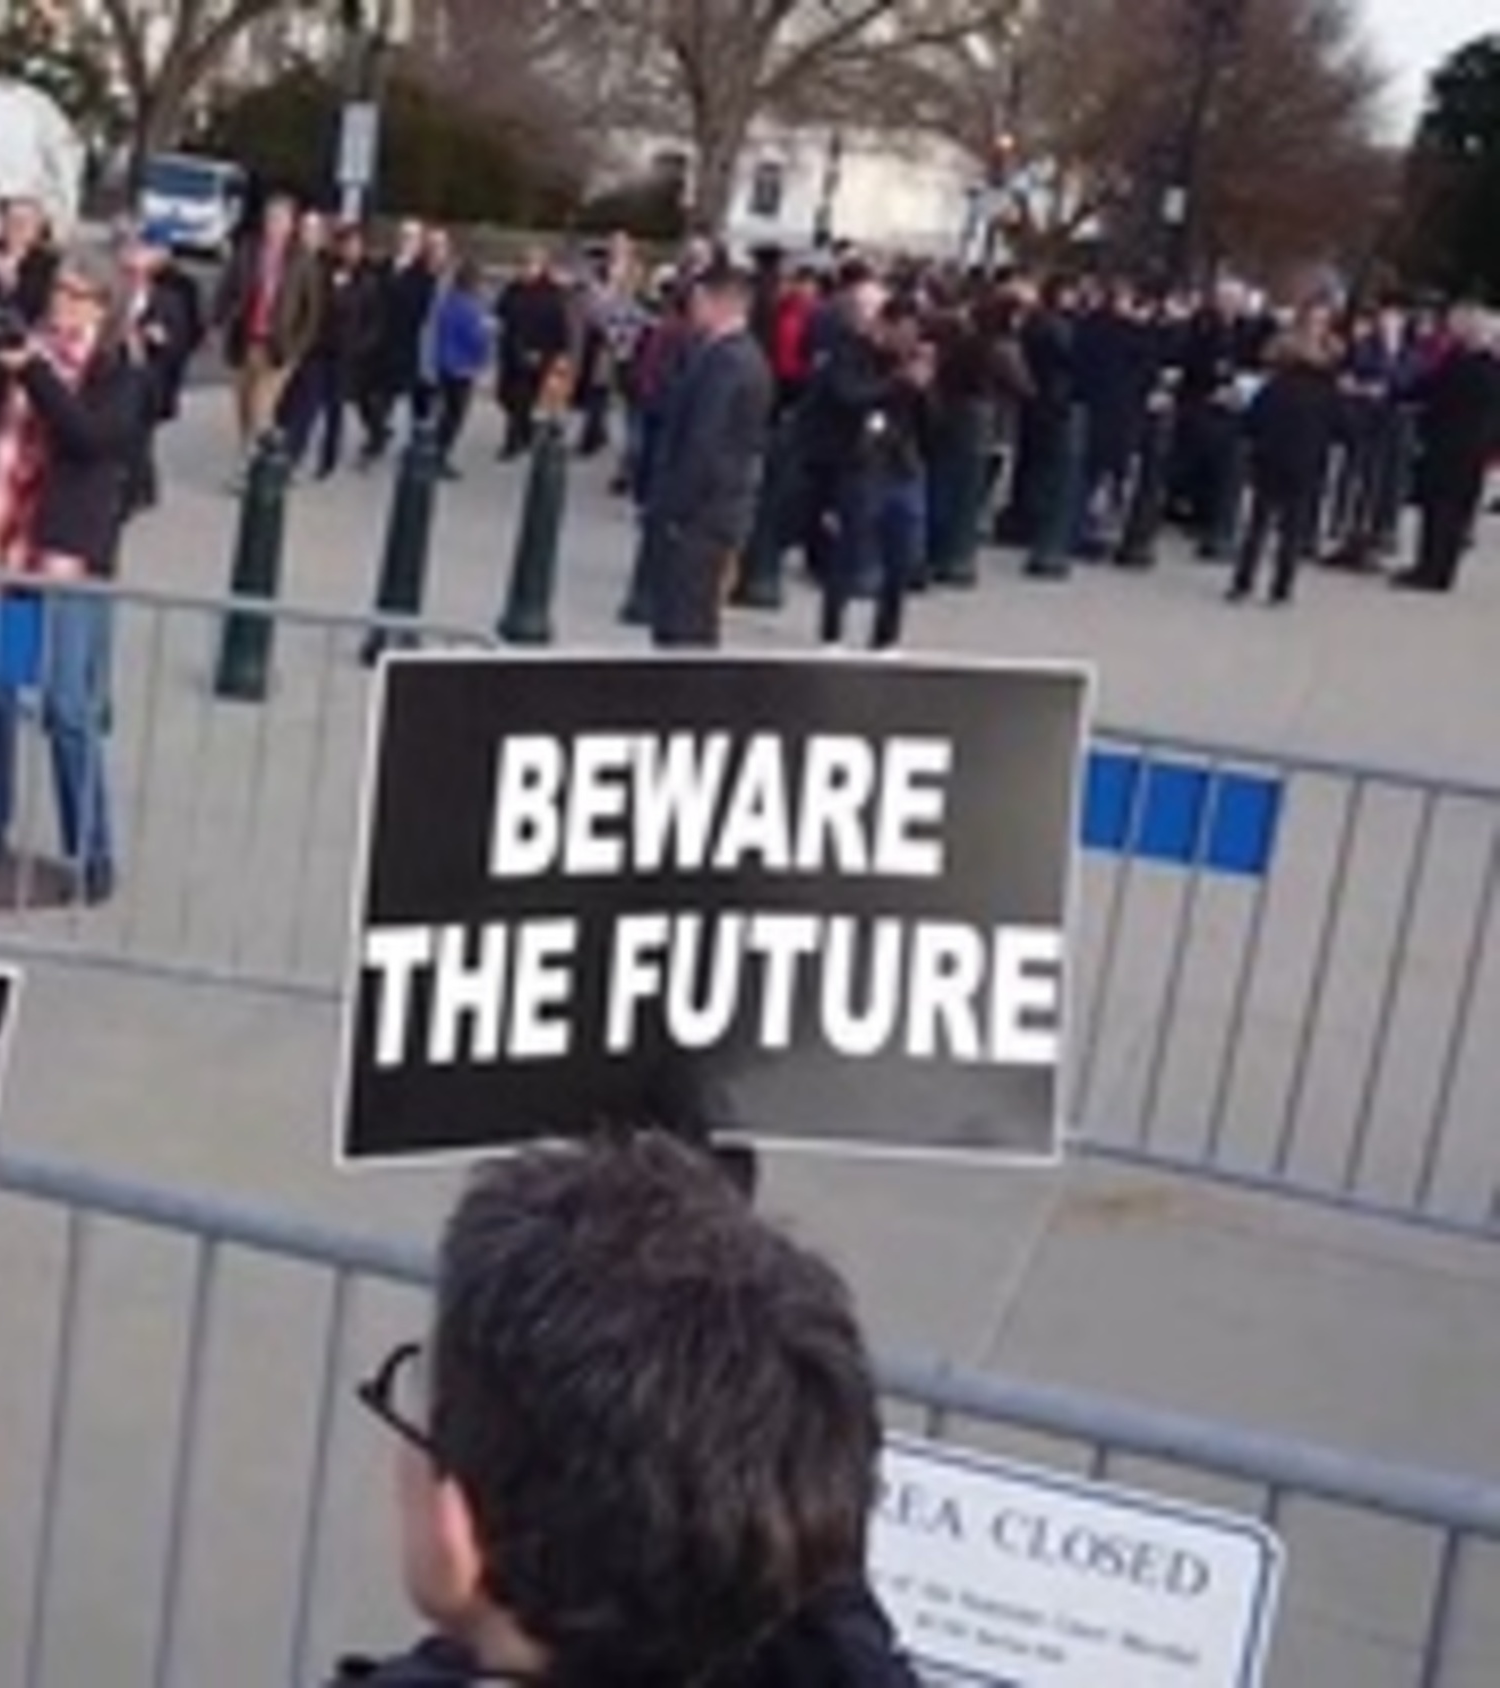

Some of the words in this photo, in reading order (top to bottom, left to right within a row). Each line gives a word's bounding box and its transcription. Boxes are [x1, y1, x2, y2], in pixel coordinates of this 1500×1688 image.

[489, 733, 953, 877] BEWARE
[366, 918, 577, 1067] THE
[605, 913, 1062, 1064] FUTURE
[991, 1506, 1211, 1597] CLOSED
